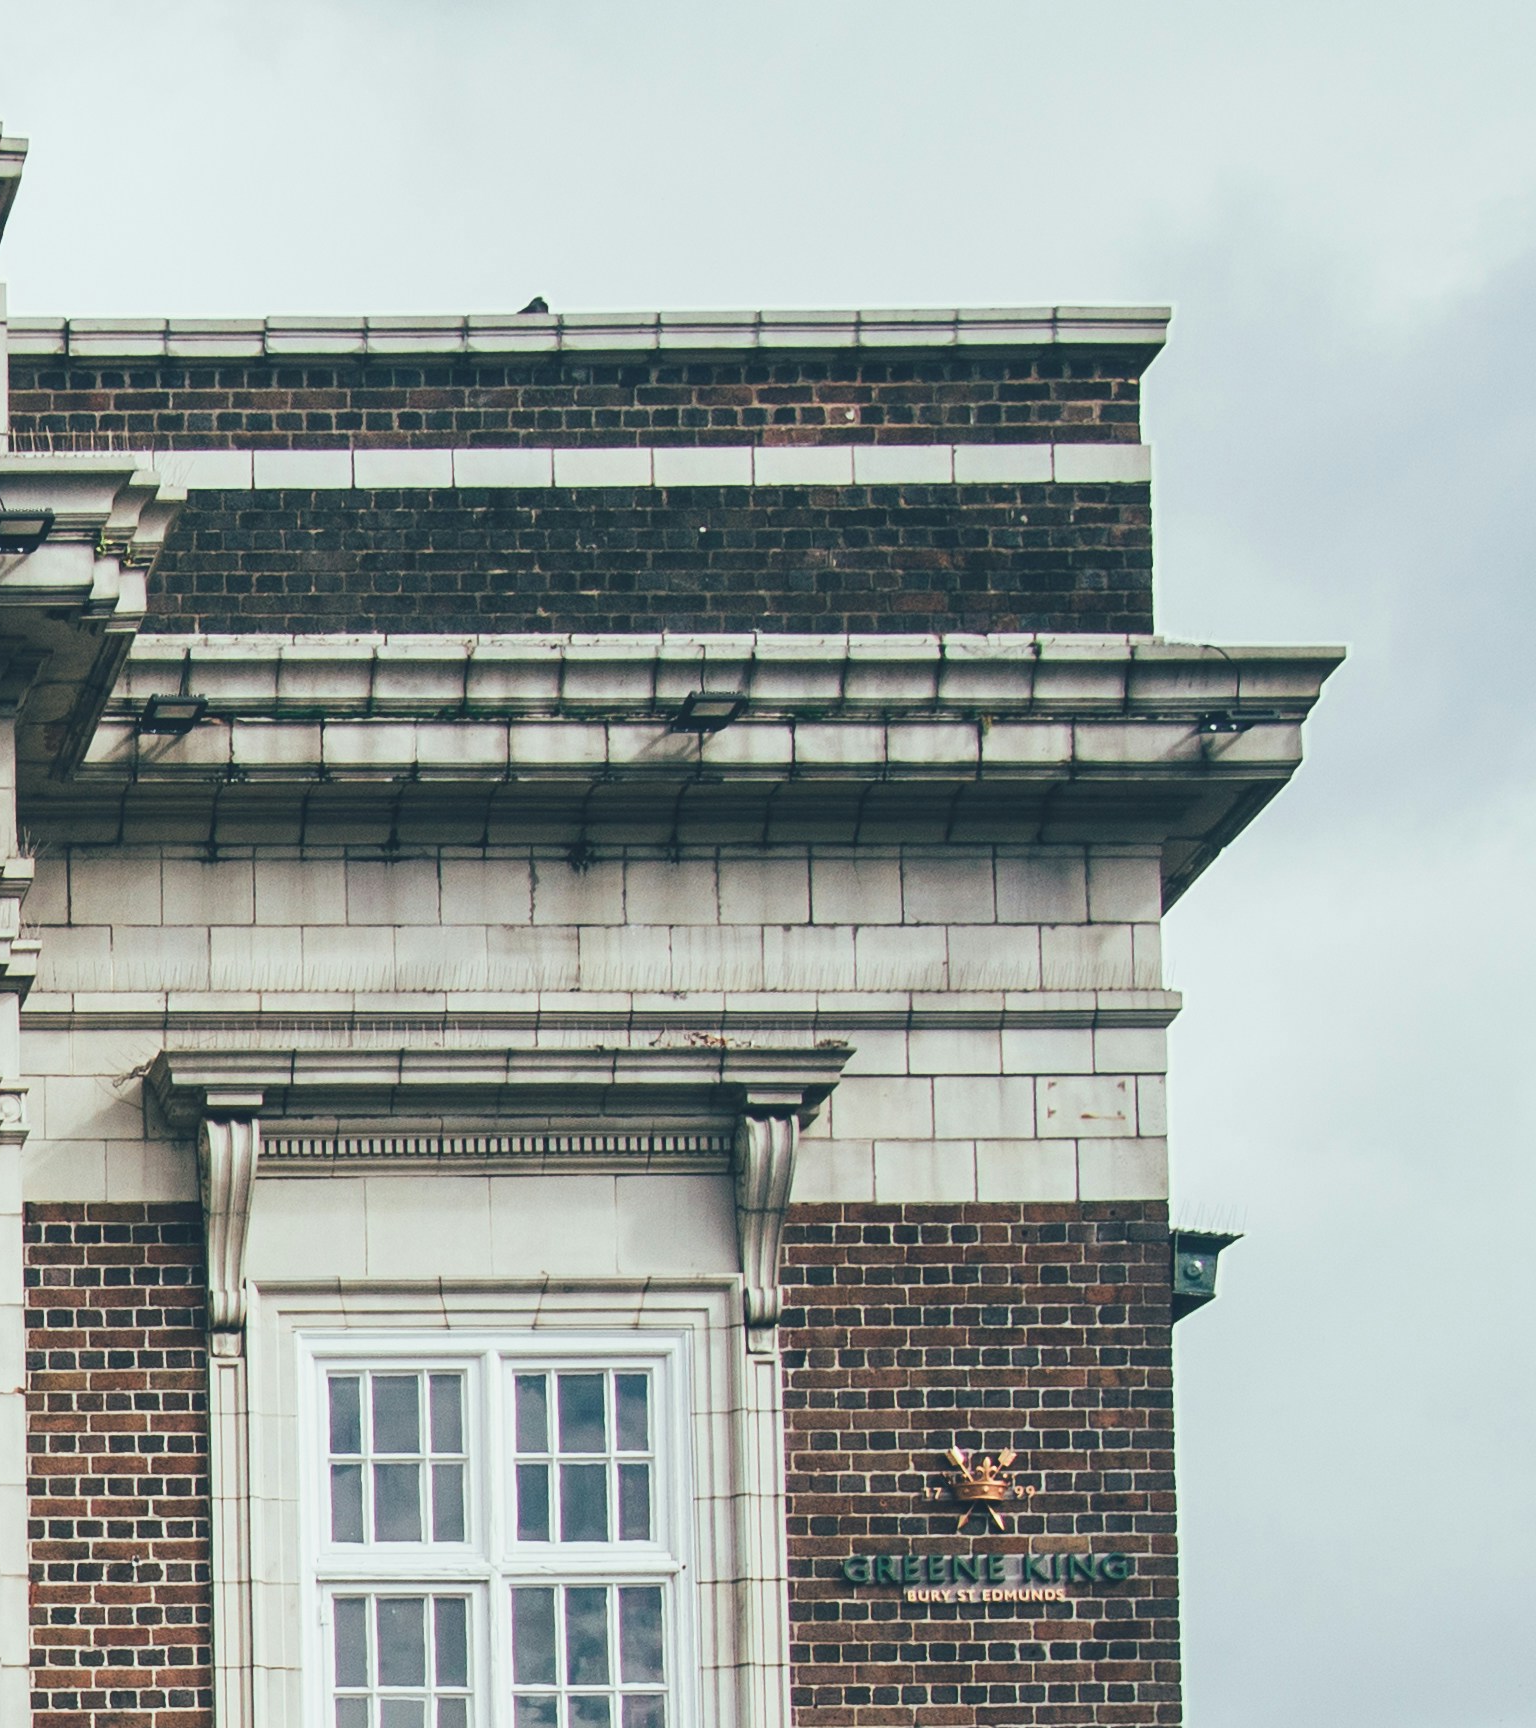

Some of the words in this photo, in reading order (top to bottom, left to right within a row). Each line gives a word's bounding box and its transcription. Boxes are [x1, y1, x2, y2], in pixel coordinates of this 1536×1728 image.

[843, 1553, 1005, 1585] GREENE
[1023, 1551, 1129, 1584] KING
[907, 1588, 951, 1601] BURY
[957, 1588, 976, 1601] ST
[982, 1587, 1066, 1601] EDMUNDS
